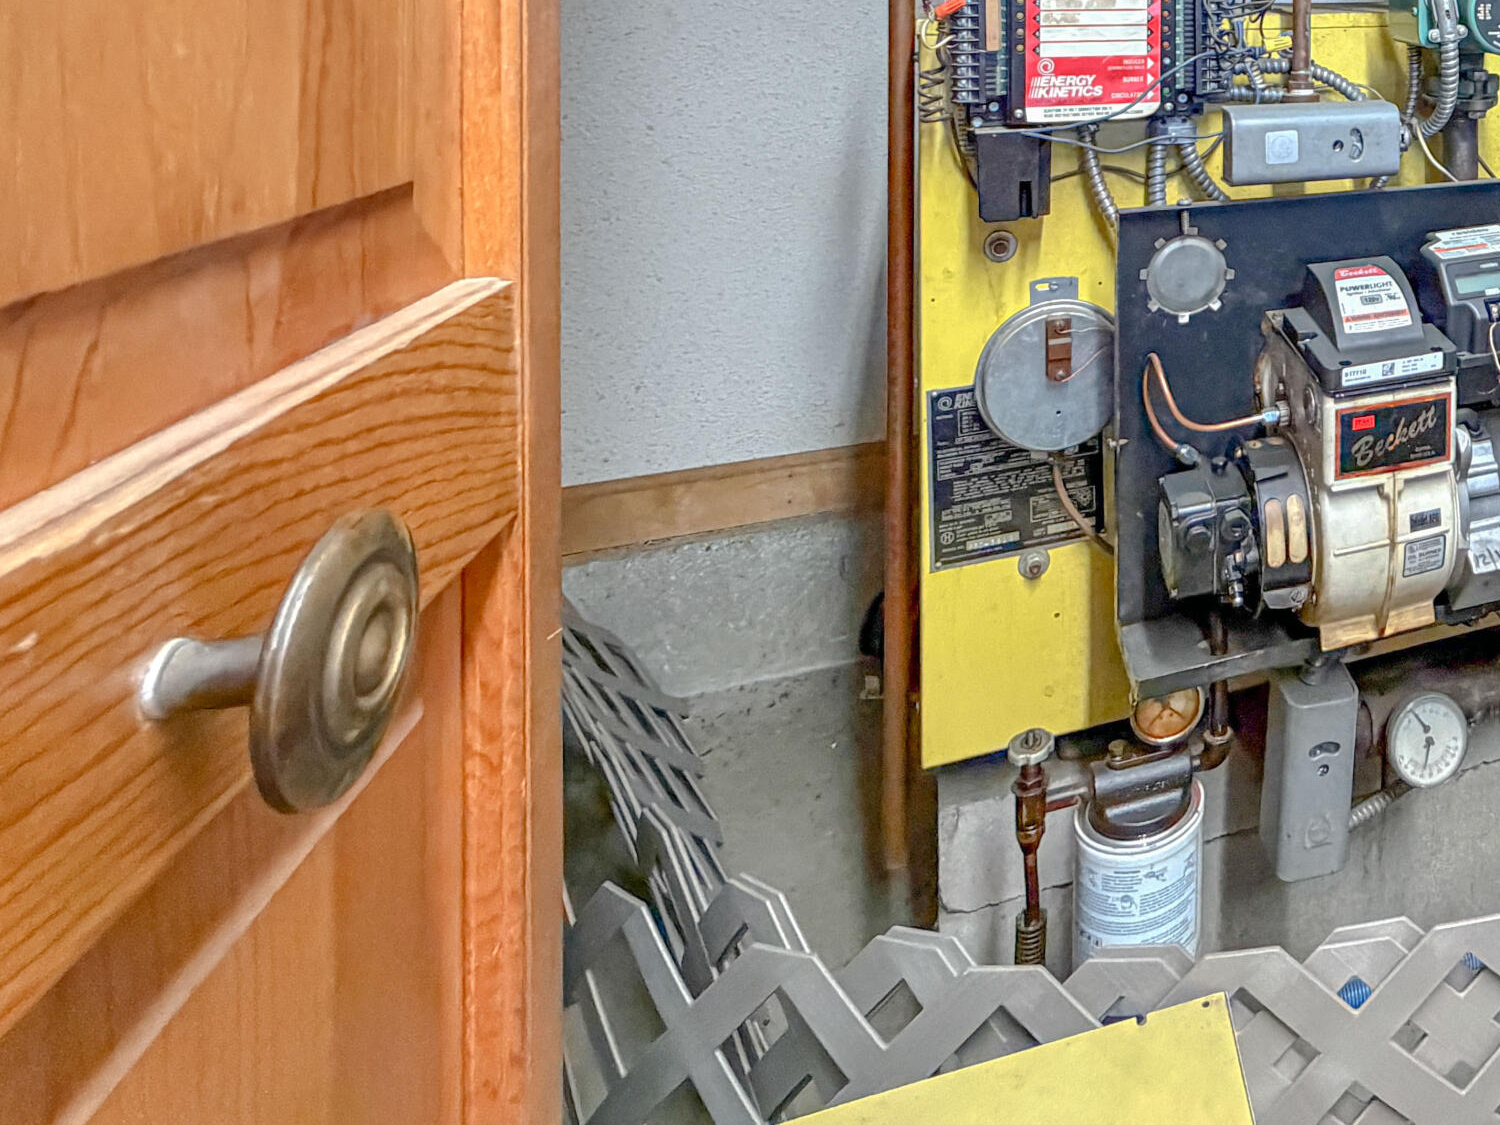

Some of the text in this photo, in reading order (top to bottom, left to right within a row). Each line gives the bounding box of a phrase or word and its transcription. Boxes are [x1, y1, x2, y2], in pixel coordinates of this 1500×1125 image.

[1038, 75, 1096, 87] ENERGY
[1036, 86, 1103, 99] KINETICS
[1340, 280, 1393, 292] POWERLIGHT
[1351, 405, 1437, 467] Beckett
